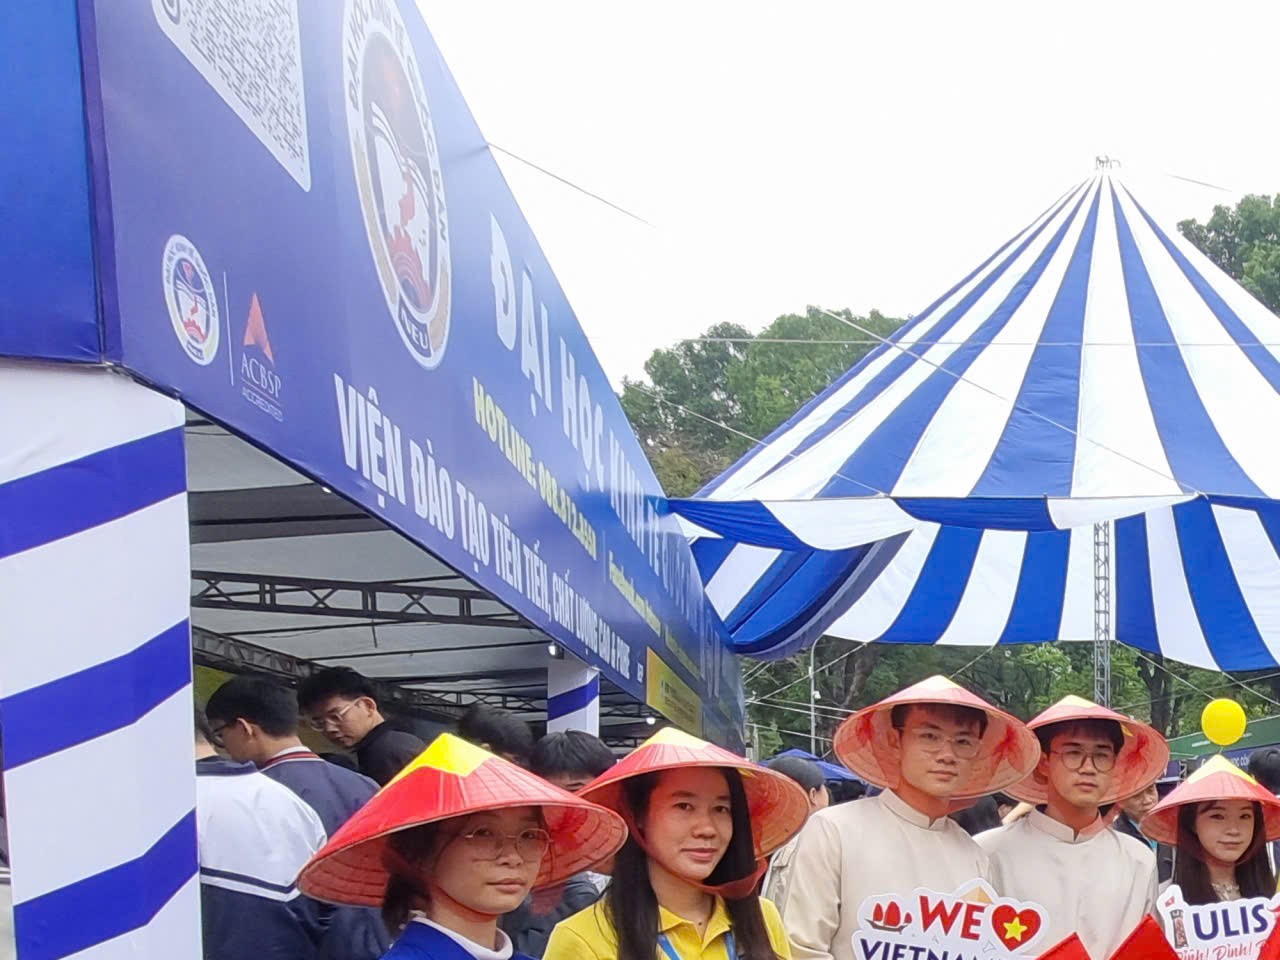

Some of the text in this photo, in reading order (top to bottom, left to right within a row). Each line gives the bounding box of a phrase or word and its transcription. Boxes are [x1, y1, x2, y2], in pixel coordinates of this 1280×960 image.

[401, 306, 429, 350] NEU
[241, 352, 281, 398] ACBSP
[490, 211, 552, 417] ĐẠI
[560, 336, 604, 493] HỌC
[472, 376, 537, 491] HOTLINE:
[333, 373, 406, 509] VIỆN
[410, 438, 455, 540] ĐÀO
[456, 480, 490, 573] TẠO
[491, 513, 523, 594] TIÊN
[918, 895, 987, 941] WE
[1192, 903, 1269, 941] ULIS
